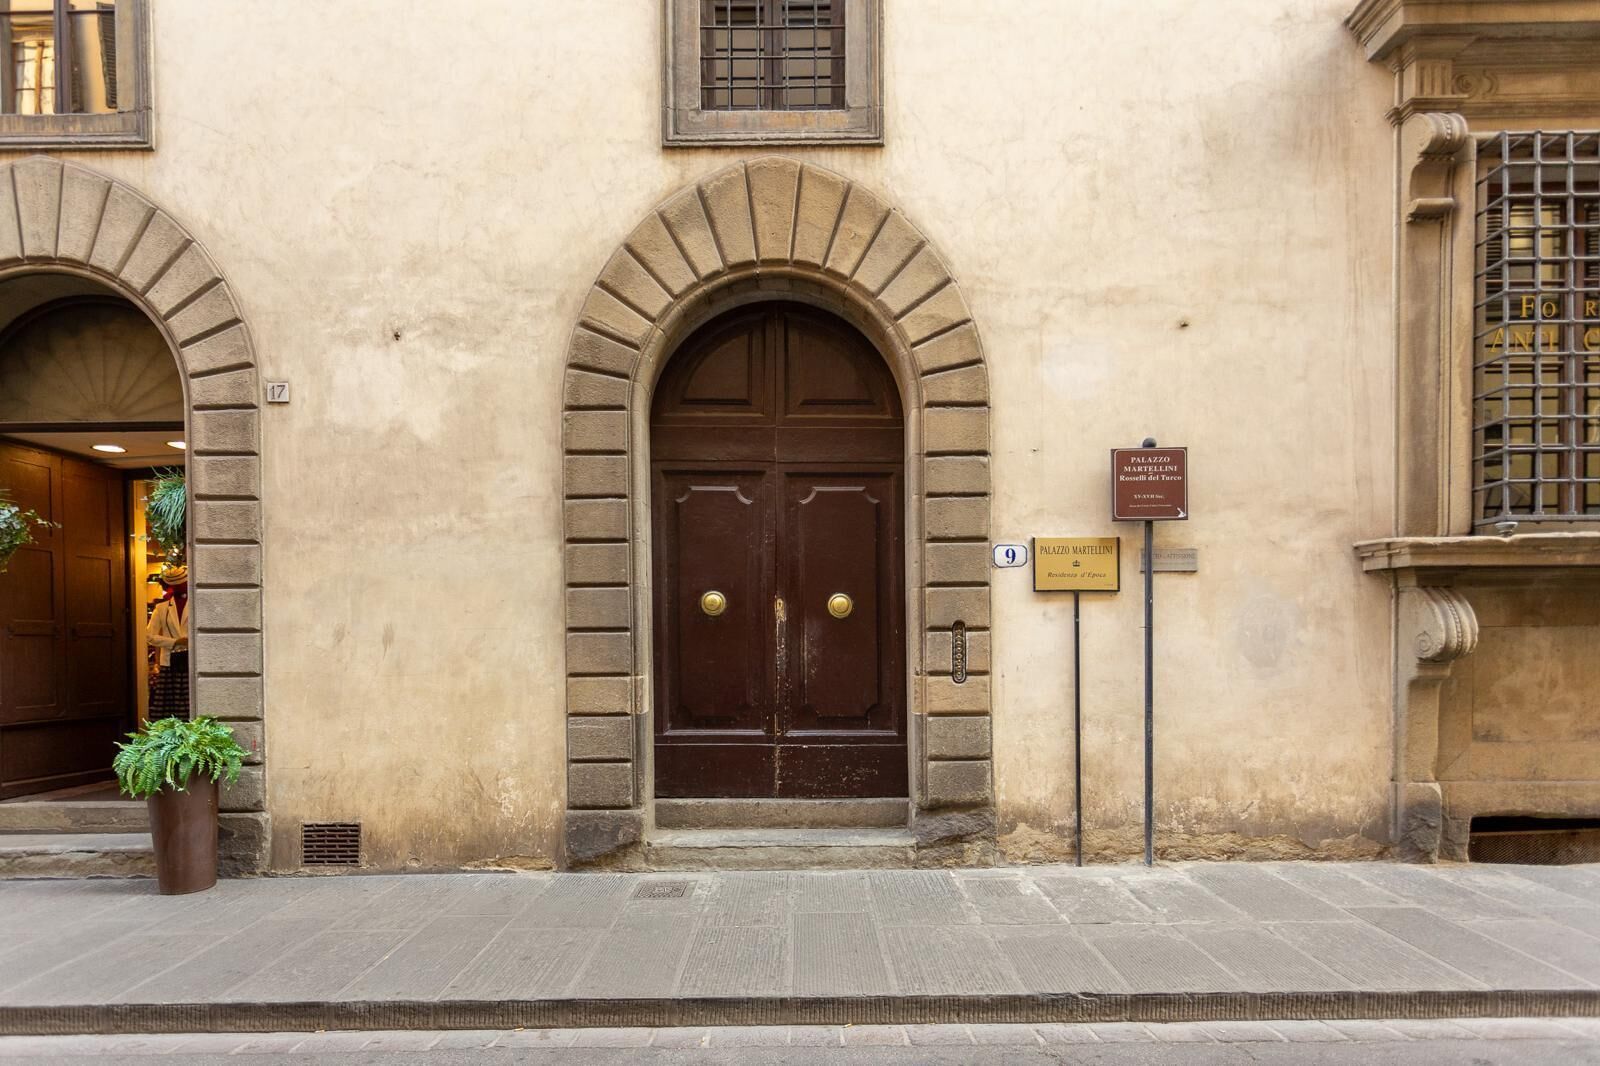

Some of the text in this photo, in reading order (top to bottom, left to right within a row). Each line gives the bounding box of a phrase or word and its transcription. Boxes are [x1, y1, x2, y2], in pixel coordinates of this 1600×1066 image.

[271, 384, 286, 400] 17
[1130, 455, 1170, 463] PALAZZO
[1040, 545, 1113, 555] PALAZZO MARTELLINI
[1005, 547, 1016, 564] 9
[1080, 571, 1107, 579] d'Epoca
